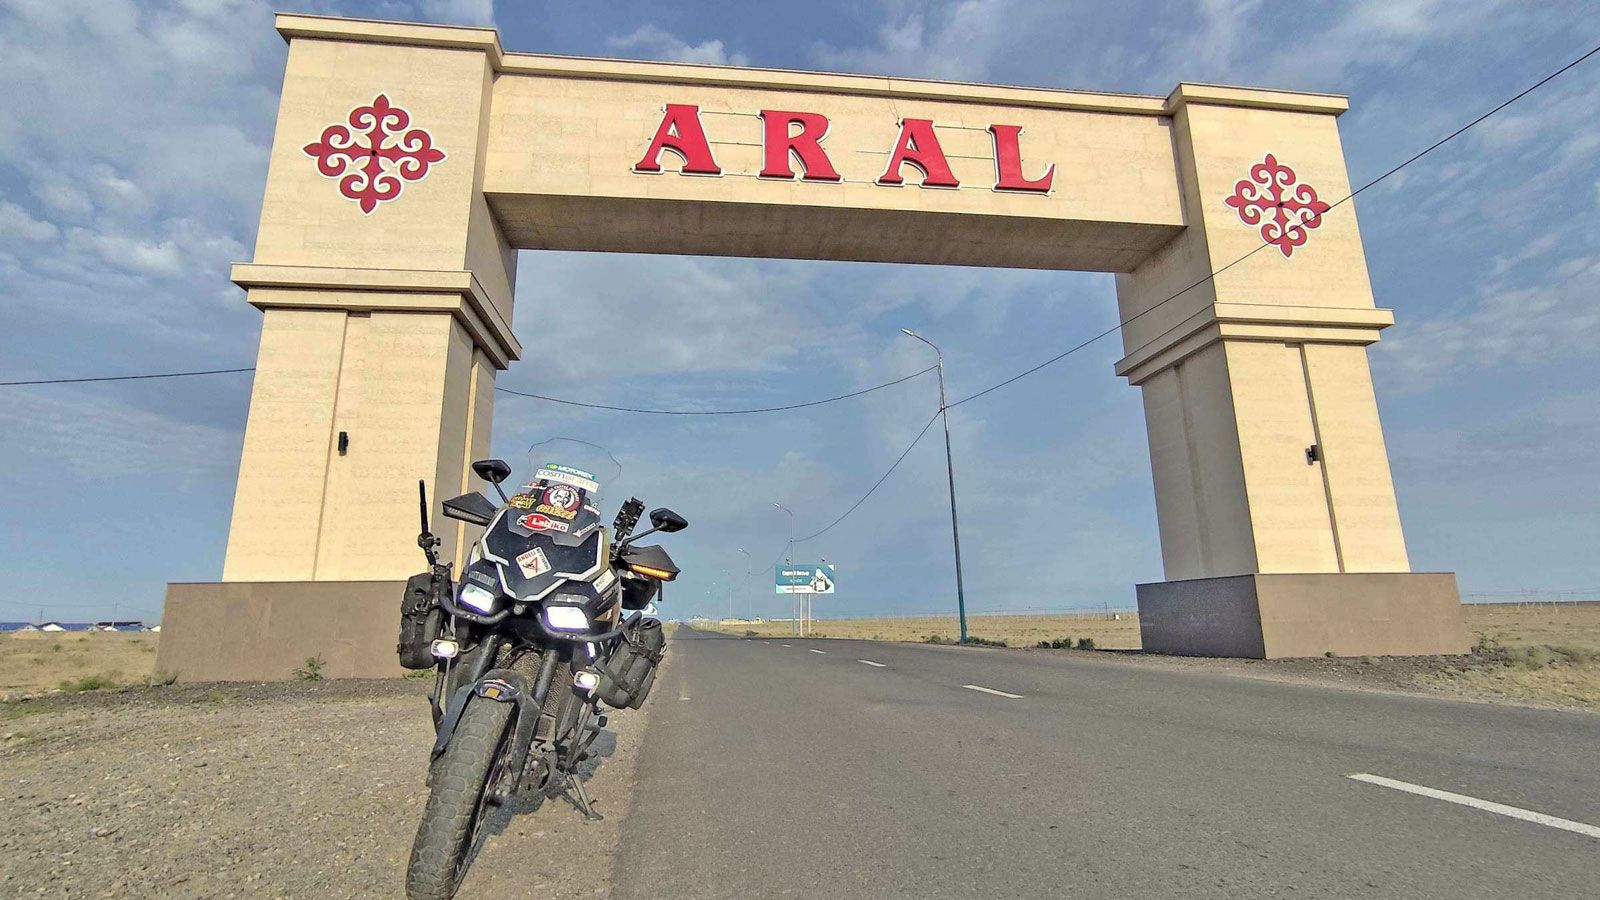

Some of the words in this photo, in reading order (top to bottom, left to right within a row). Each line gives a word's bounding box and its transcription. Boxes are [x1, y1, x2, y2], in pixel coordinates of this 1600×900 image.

[633, 103, 1056, 194] ARAL
[557, 465, 594, 480] MOTOREX
[531, 518, 567, 531] Labiko
